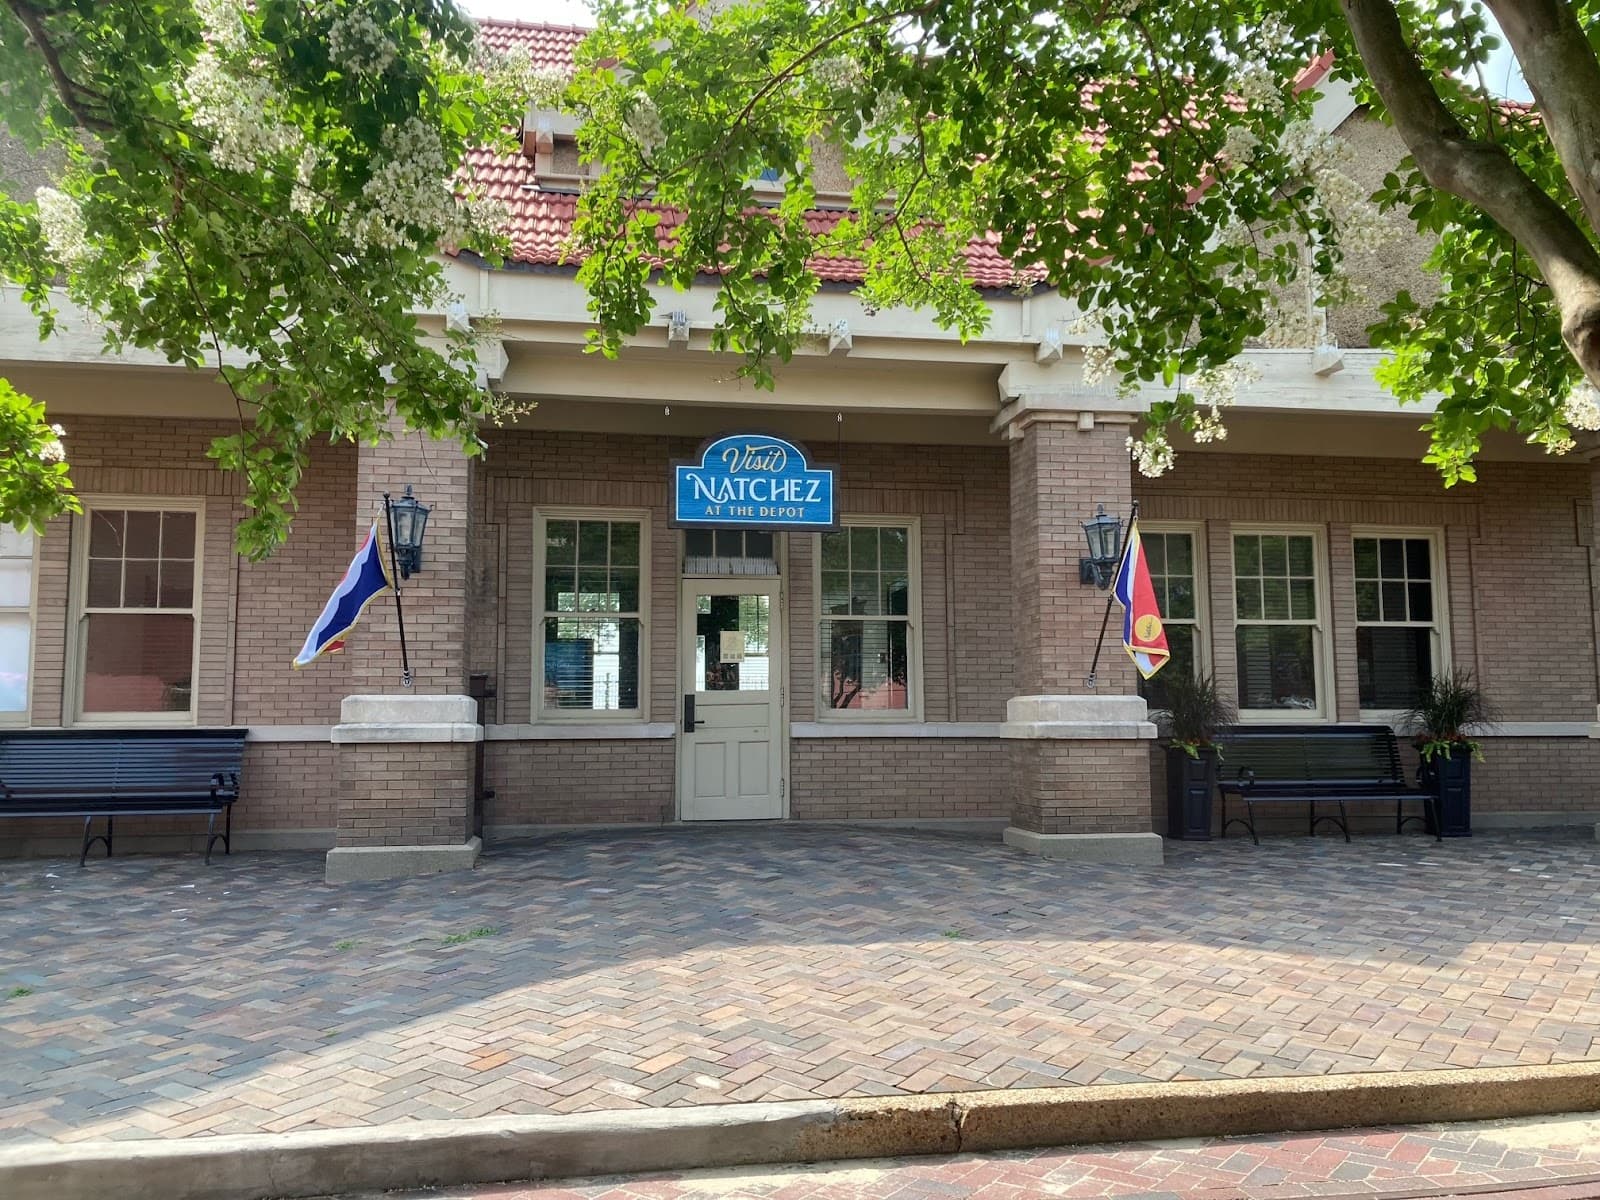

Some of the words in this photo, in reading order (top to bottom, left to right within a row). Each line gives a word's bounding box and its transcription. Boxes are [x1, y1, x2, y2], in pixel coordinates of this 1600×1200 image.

[722, 444, 787, 474] Visit
[686, 473, 822, 503] NATCHEZ
[705, 505, 722, 516] AT
[729, 506, 755, 517] THE
[759, 507, 805, 518] DEPOT
